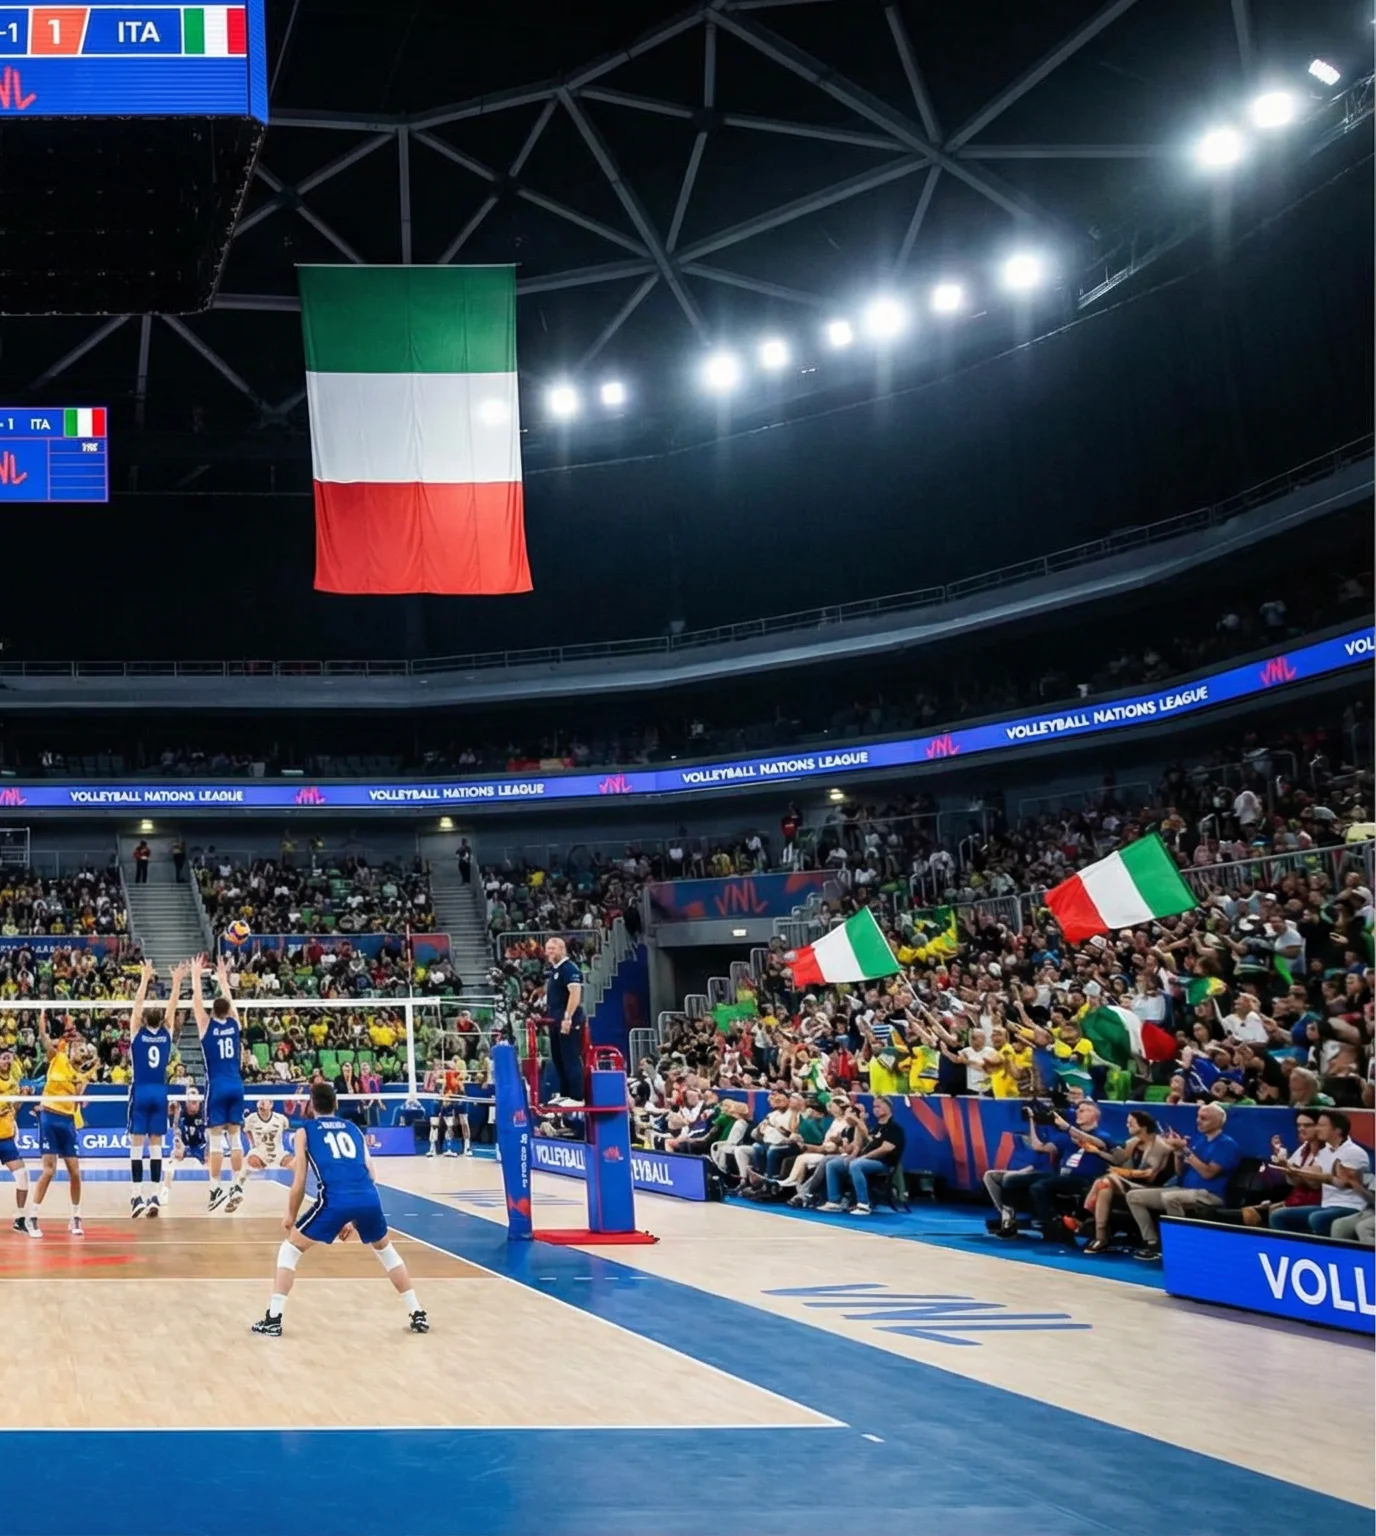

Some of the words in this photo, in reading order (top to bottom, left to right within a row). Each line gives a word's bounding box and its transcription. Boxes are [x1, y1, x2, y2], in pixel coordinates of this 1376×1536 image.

[48, 19, 62, 45] 1
[117, 21, 161, 43] ITA
[30, 418, 51, 430] ITA
[1005, 713, 1089, 740] VOLLEYBALL
[1093, 701, 1157, 725] NATIONS
[1159, 686, 1208, 712] LEAGUE
[148, 1045, 160, 1068] 9
[217, 1037, 235, 1059] 18
[323, 1131, 357, 1159] 10
[1258, 1252, 1376, 1316] VOLL
